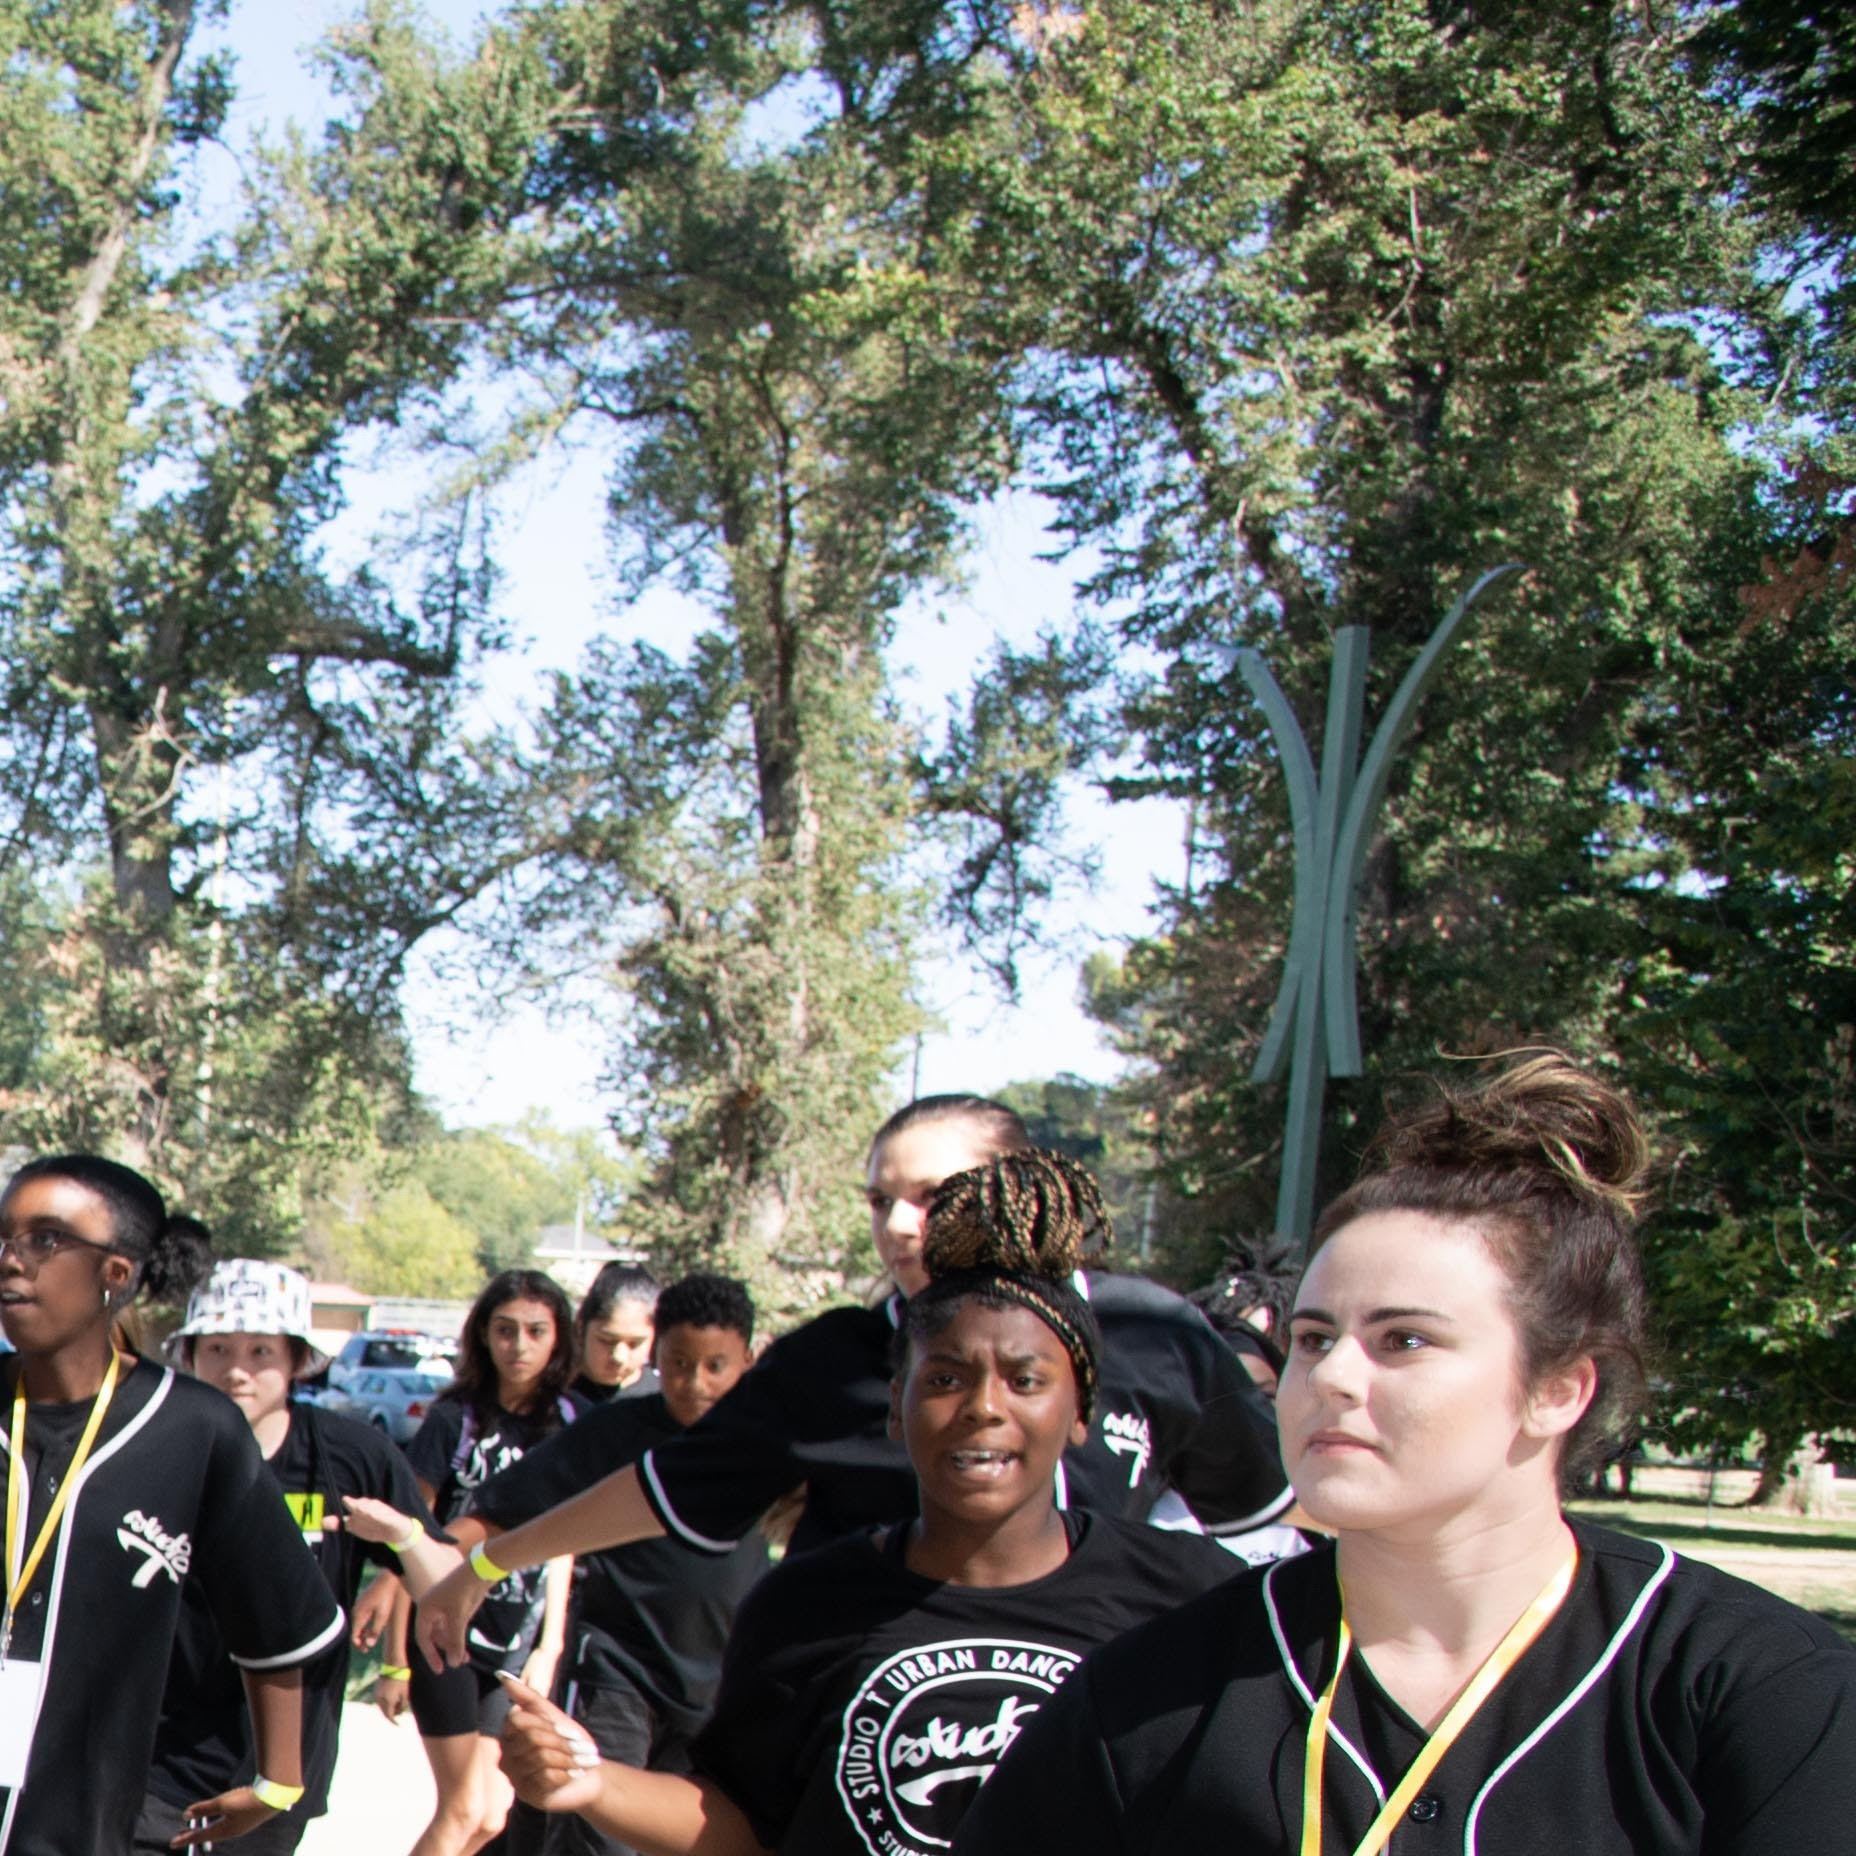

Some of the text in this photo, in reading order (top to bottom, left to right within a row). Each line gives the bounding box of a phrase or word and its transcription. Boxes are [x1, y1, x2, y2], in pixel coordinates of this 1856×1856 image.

[845, 1717, 880, 1800] STUDIO
[884, 1649, 977, 1692] URBAN
[990, 1650, 1075, 1685] DANC
